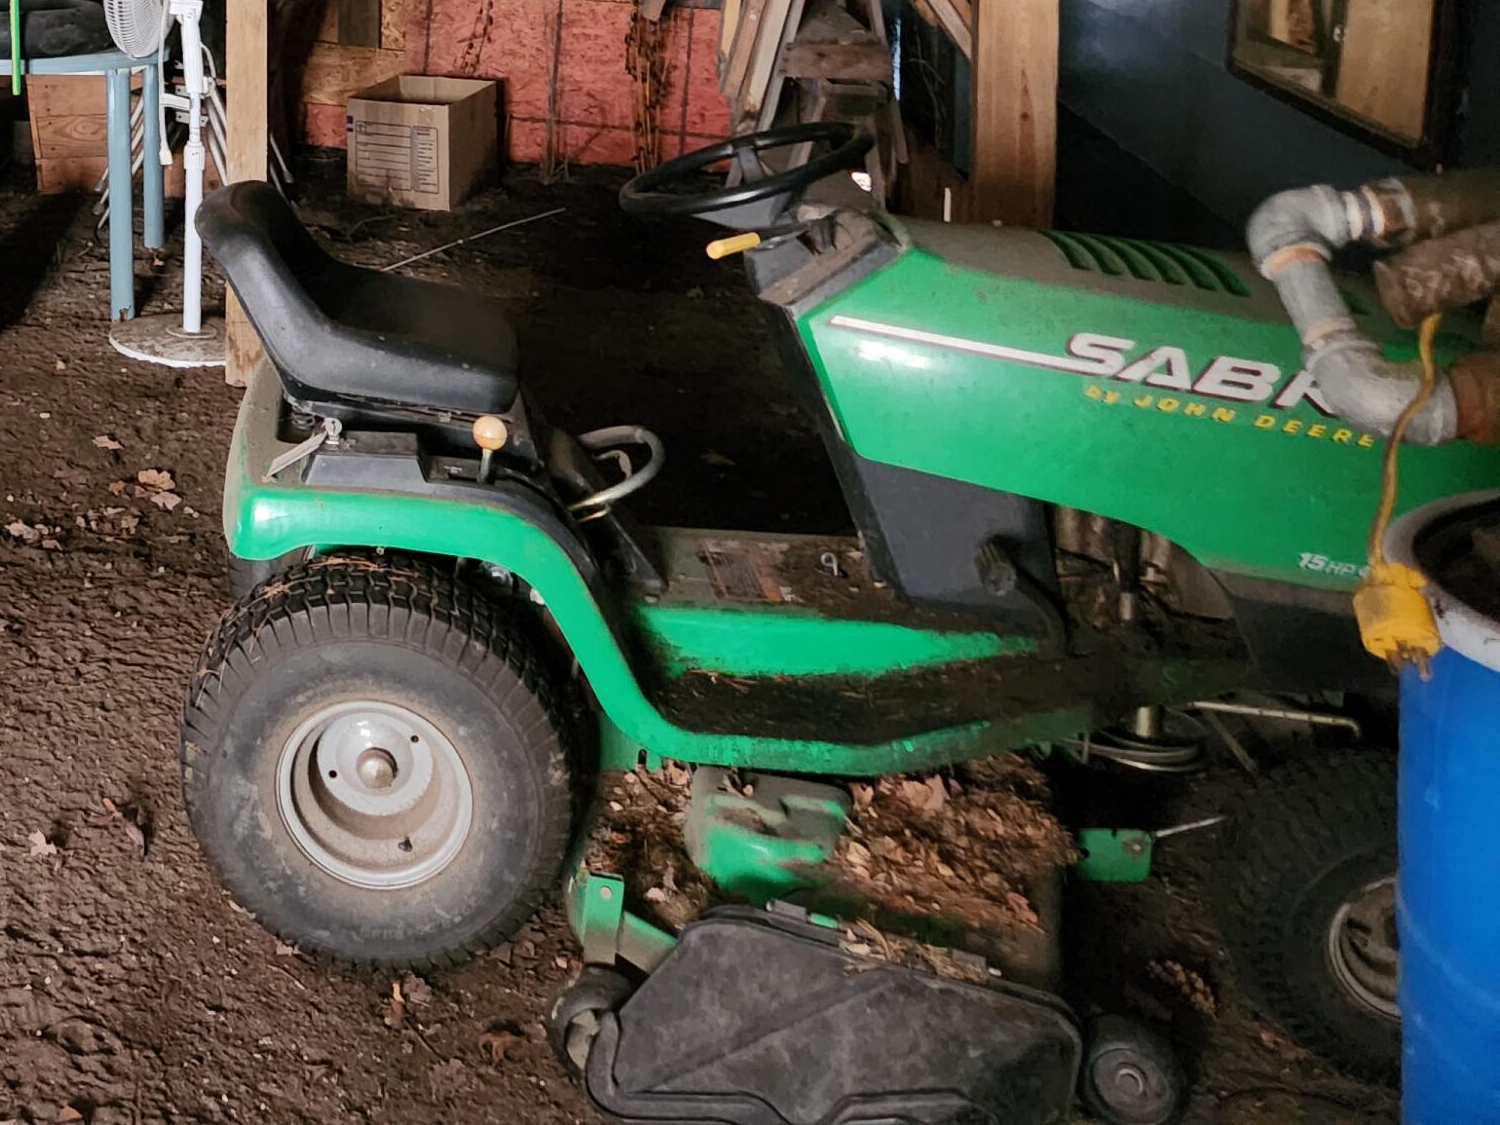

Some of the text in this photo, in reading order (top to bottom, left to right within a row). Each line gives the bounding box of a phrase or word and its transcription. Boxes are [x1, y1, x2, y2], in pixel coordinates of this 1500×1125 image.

[1067, 331, 1338, 416] SABR
[1134, 394, 1236, 423] JOHN
[1254, 414, 1375, 448] DEERE
